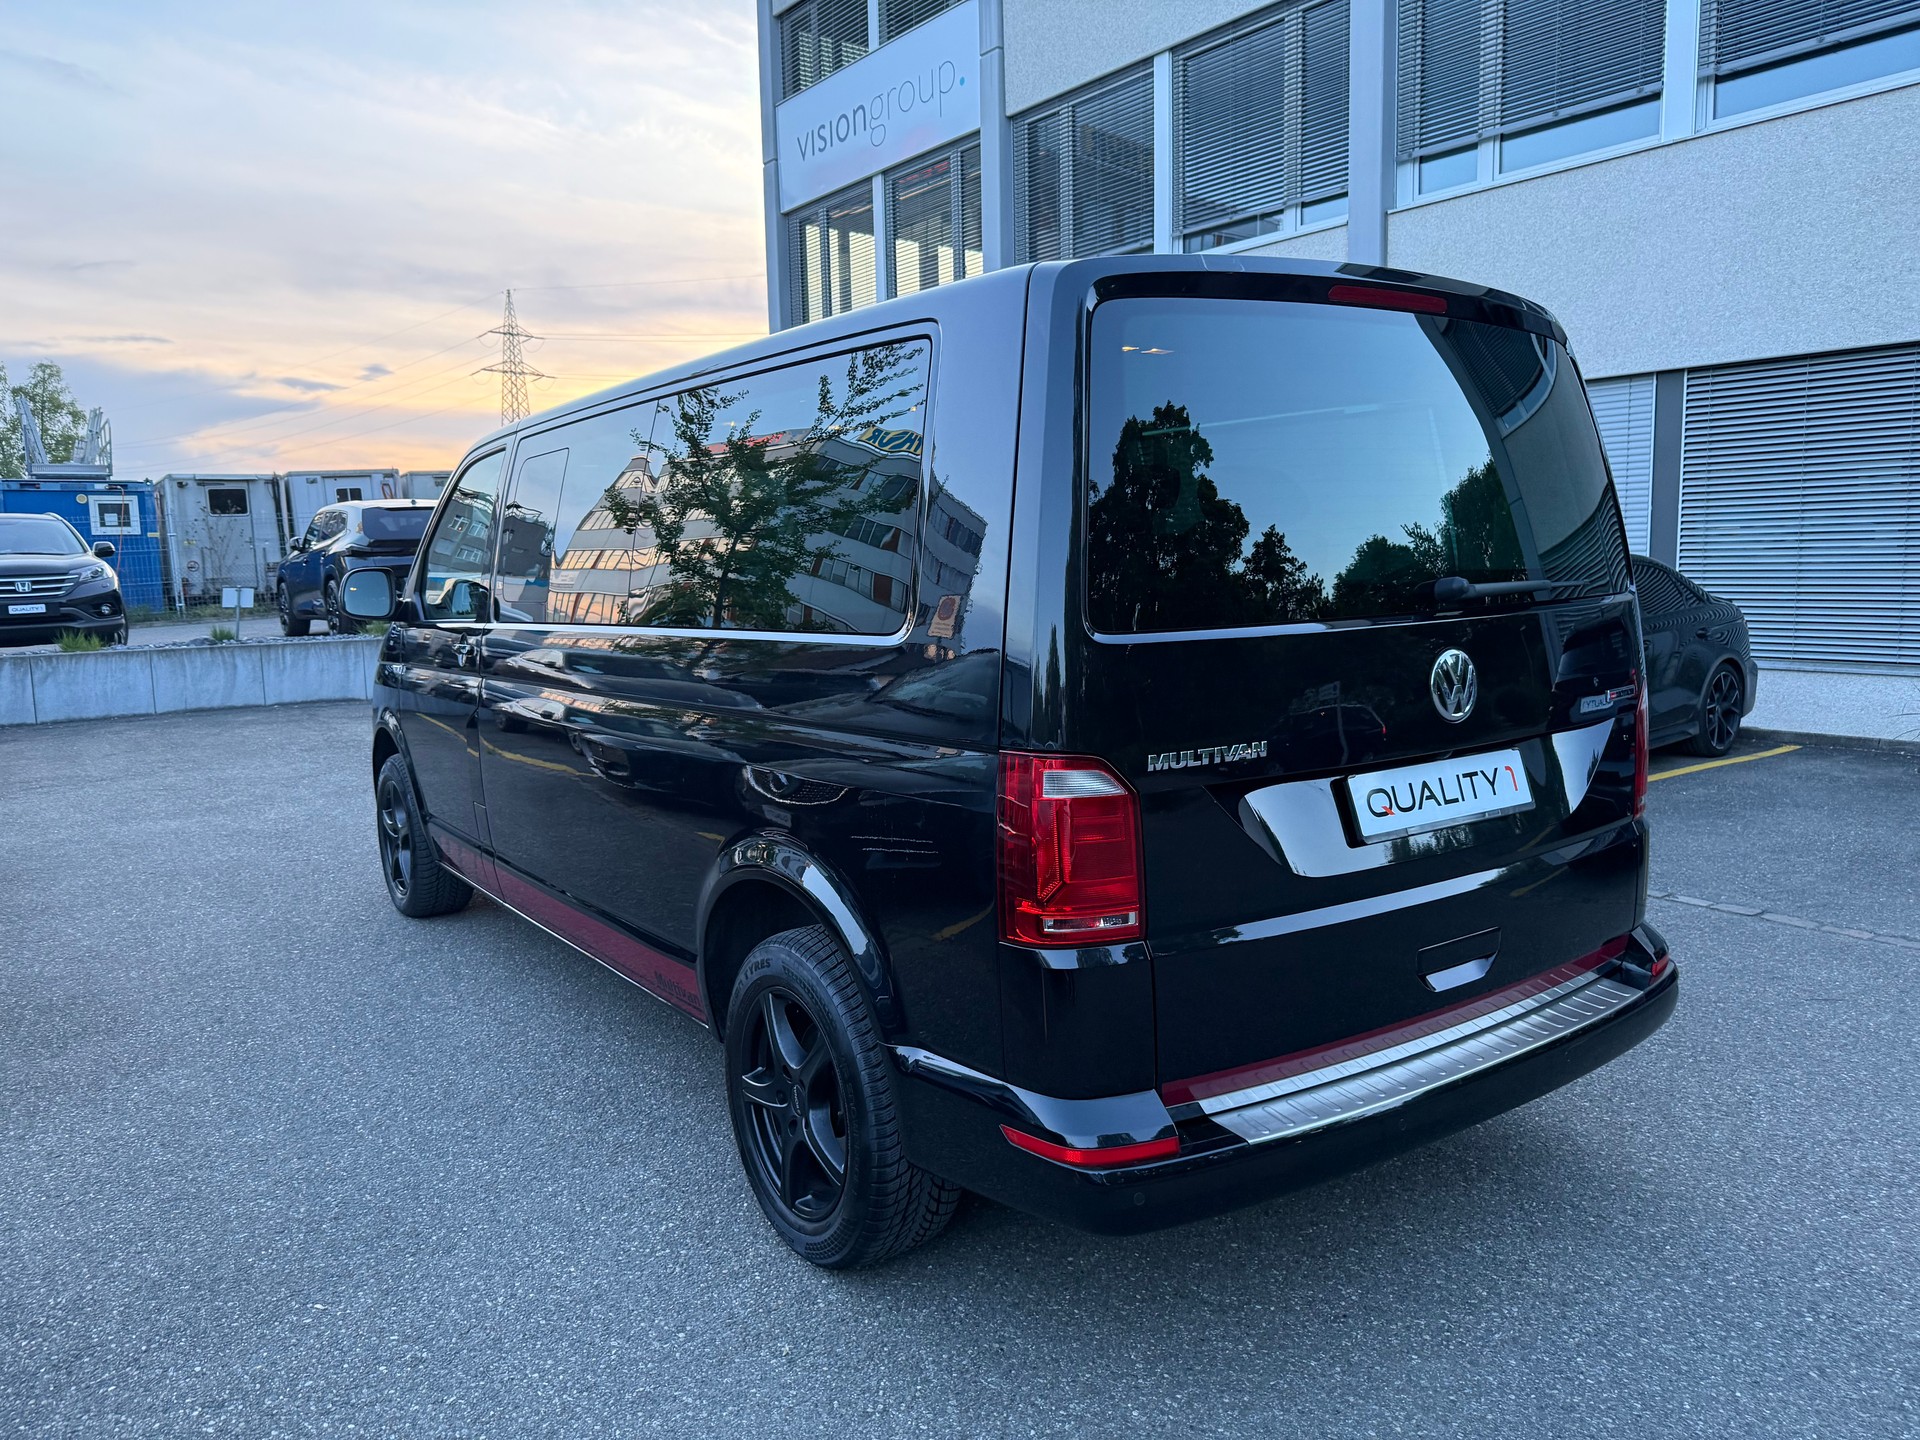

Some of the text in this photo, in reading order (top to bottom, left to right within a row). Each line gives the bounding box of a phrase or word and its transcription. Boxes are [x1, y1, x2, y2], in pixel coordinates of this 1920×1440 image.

[1147, 740, 1268, 772] MULTIVAN
[1366, 765, 1519, 818] QUALITY 1
